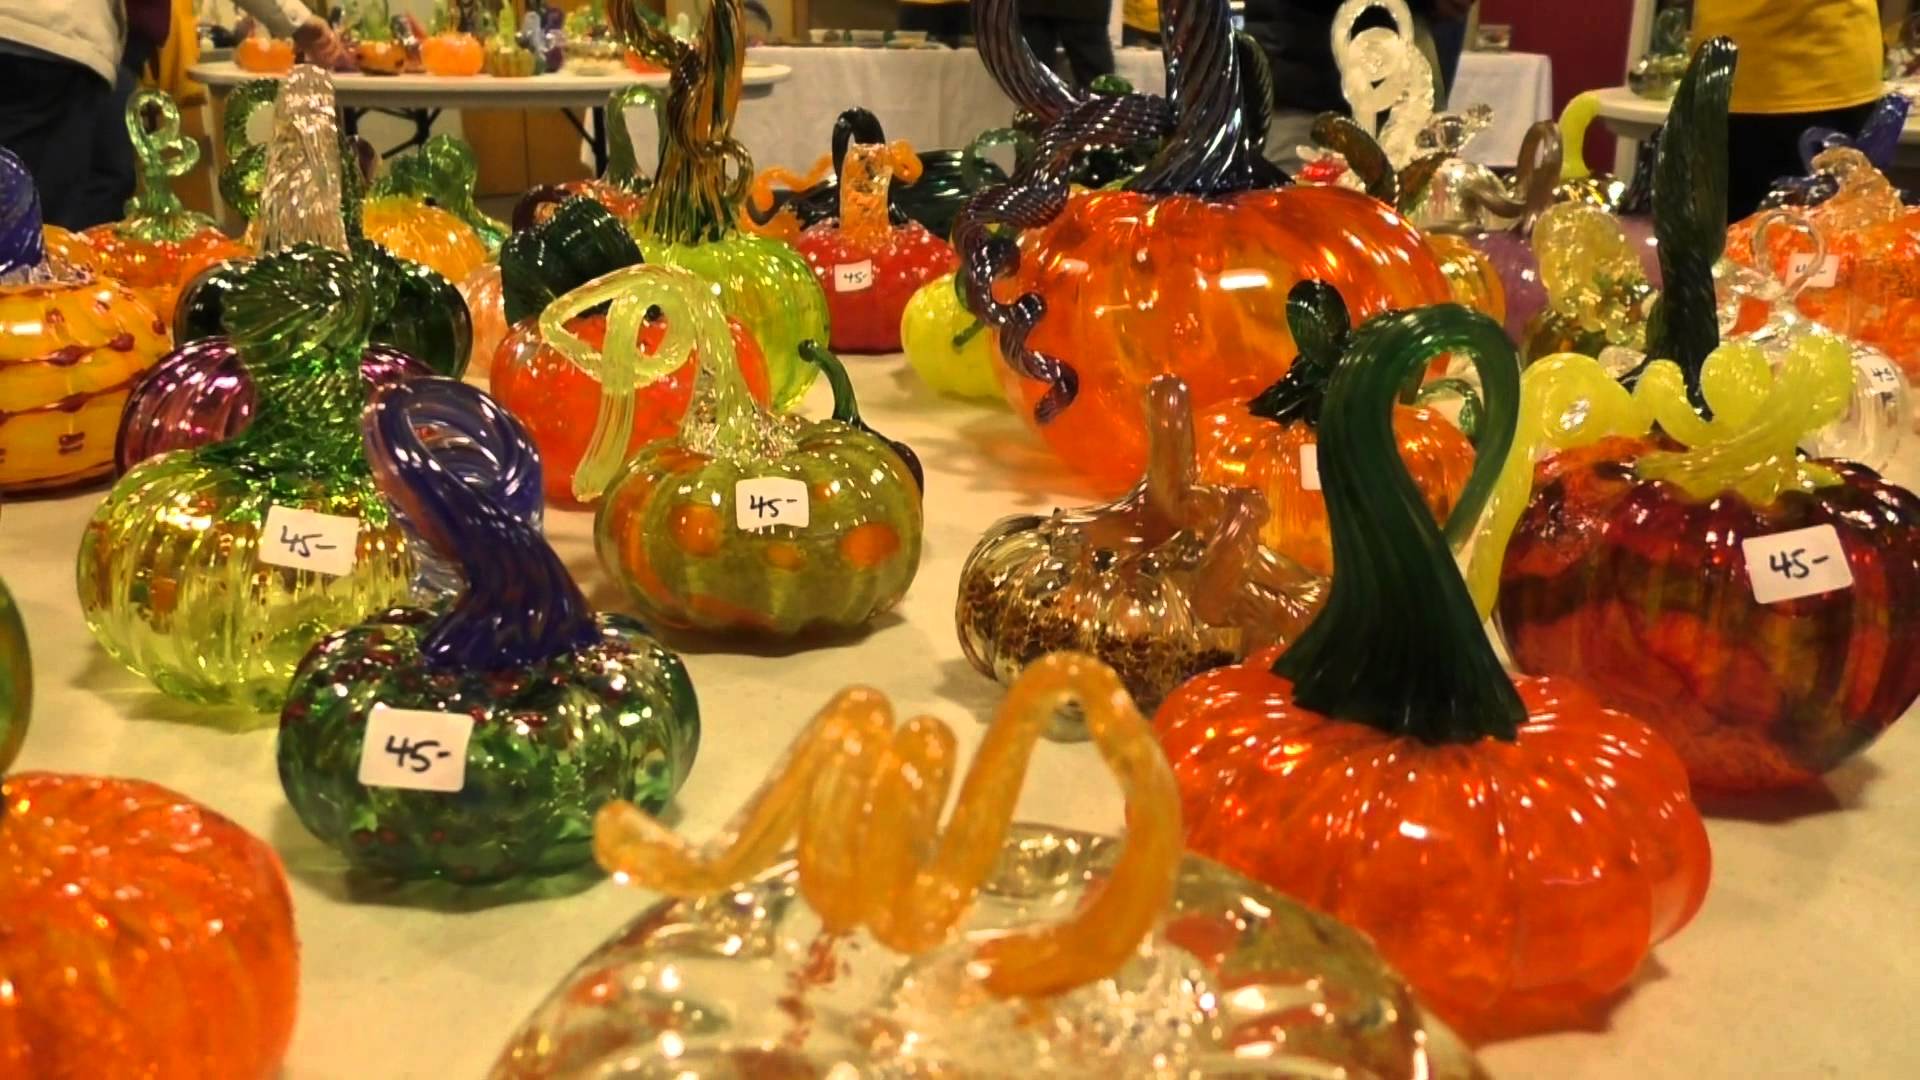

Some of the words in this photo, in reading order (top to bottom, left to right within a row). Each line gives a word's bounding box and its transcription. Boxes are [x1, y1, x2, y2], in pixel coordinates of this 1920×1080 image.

[750, 494, 798, 518] 45-
[280, 525, 337, 559] 45-
[1769, 548, 1829, 581] 45-
[385, 735, 452, 773] 45-
